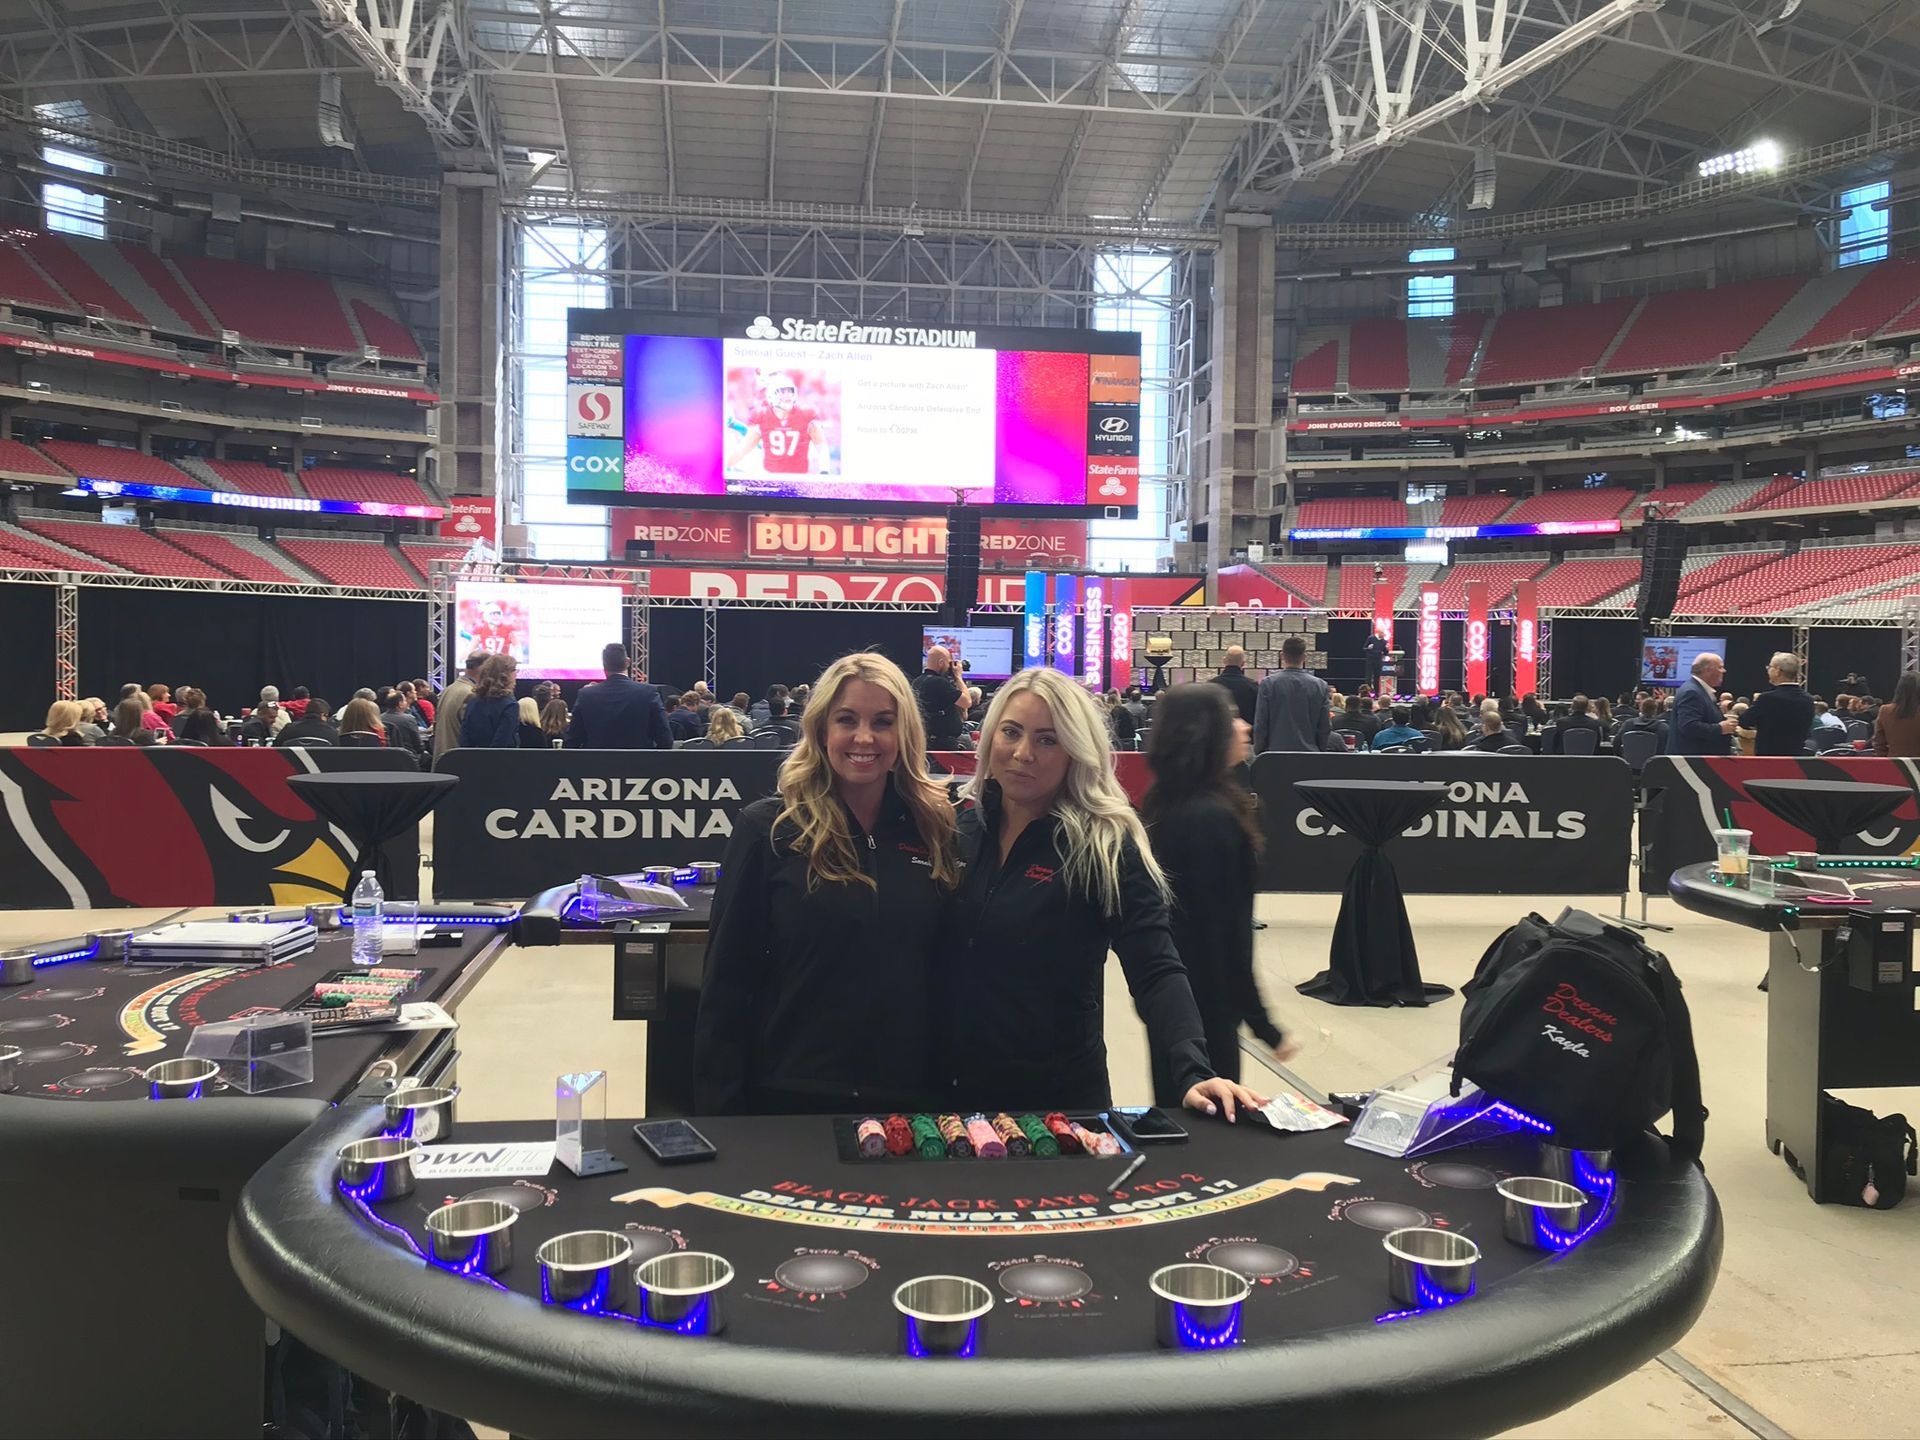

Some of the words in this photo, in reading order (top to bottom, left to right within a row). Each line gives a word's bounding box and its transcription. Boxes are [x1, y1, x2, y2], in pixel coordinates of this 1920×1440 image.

[20, 339, 57, 352] ADRIAN
[58, 345, 95, 357] WILSON
[894, 327, 976, 348] STADIUM
[775, 348, 807, 359] Guest
[817, 350, 844, 360] Zach
[846, 351, 873, 361] Allen
[326, 384, 354, 393] JIMMY
[355, 386, 409, 398] CONZELMAN
[1629, 402, 1659, 411] GREEN
[578, 422, 611, 430] SAFEWAY
[1363, 420, 1402, 429] DRISCOLL
[769, 430, 800, 456] 97
[1095, 434, 1133, 442] HYUNDAI
[570, 456, 620, 473] COX
[450, 504, 492, 515] tateFarm
[634, 525, 732, 544] REDZONE
[756, 522, 836, 552] BUD
[842, 525, 948, 555] LIGHT
[979, 535, 1066, 552] REDZONE
[1056, 614, 1073, 655] COX
[1086, 586, 1102, 685] BUSINESS
[1113, 612, 1129, 662] 2020
[1420, 591, 1439, 690] BUSINESS
[1469, 620, 1486, 663] COX
[549, 777, 742, 801] ARIZONA
[485, 808, 734, 840] CARDINA
[1554, 983, 1618, 1025] Dream
[1542, 996, 1614, 1043] Dealers
[1541, 1024, 1590, 1058] Kayla
[740, 1189, 896, 1218] DEALER
[908, 1210, 1019, 1222] MUST
[1030, 1207, 1099, 1220] HIT
[1108, 1191, 1198, 1214] SOFT
[1200, 1180, 1239, 1195] 17
[772, 1180, 891, 1205] BLACK
[900, 1197, 1000, 1210] JACK
[1014, 1193, 1101, 1209] PAYS
[1134, 1179, 1181, 1195] TO
[1180, 1173, 1205, 1183] 2
[1149, 1204, 1218, 1221] PAYS
